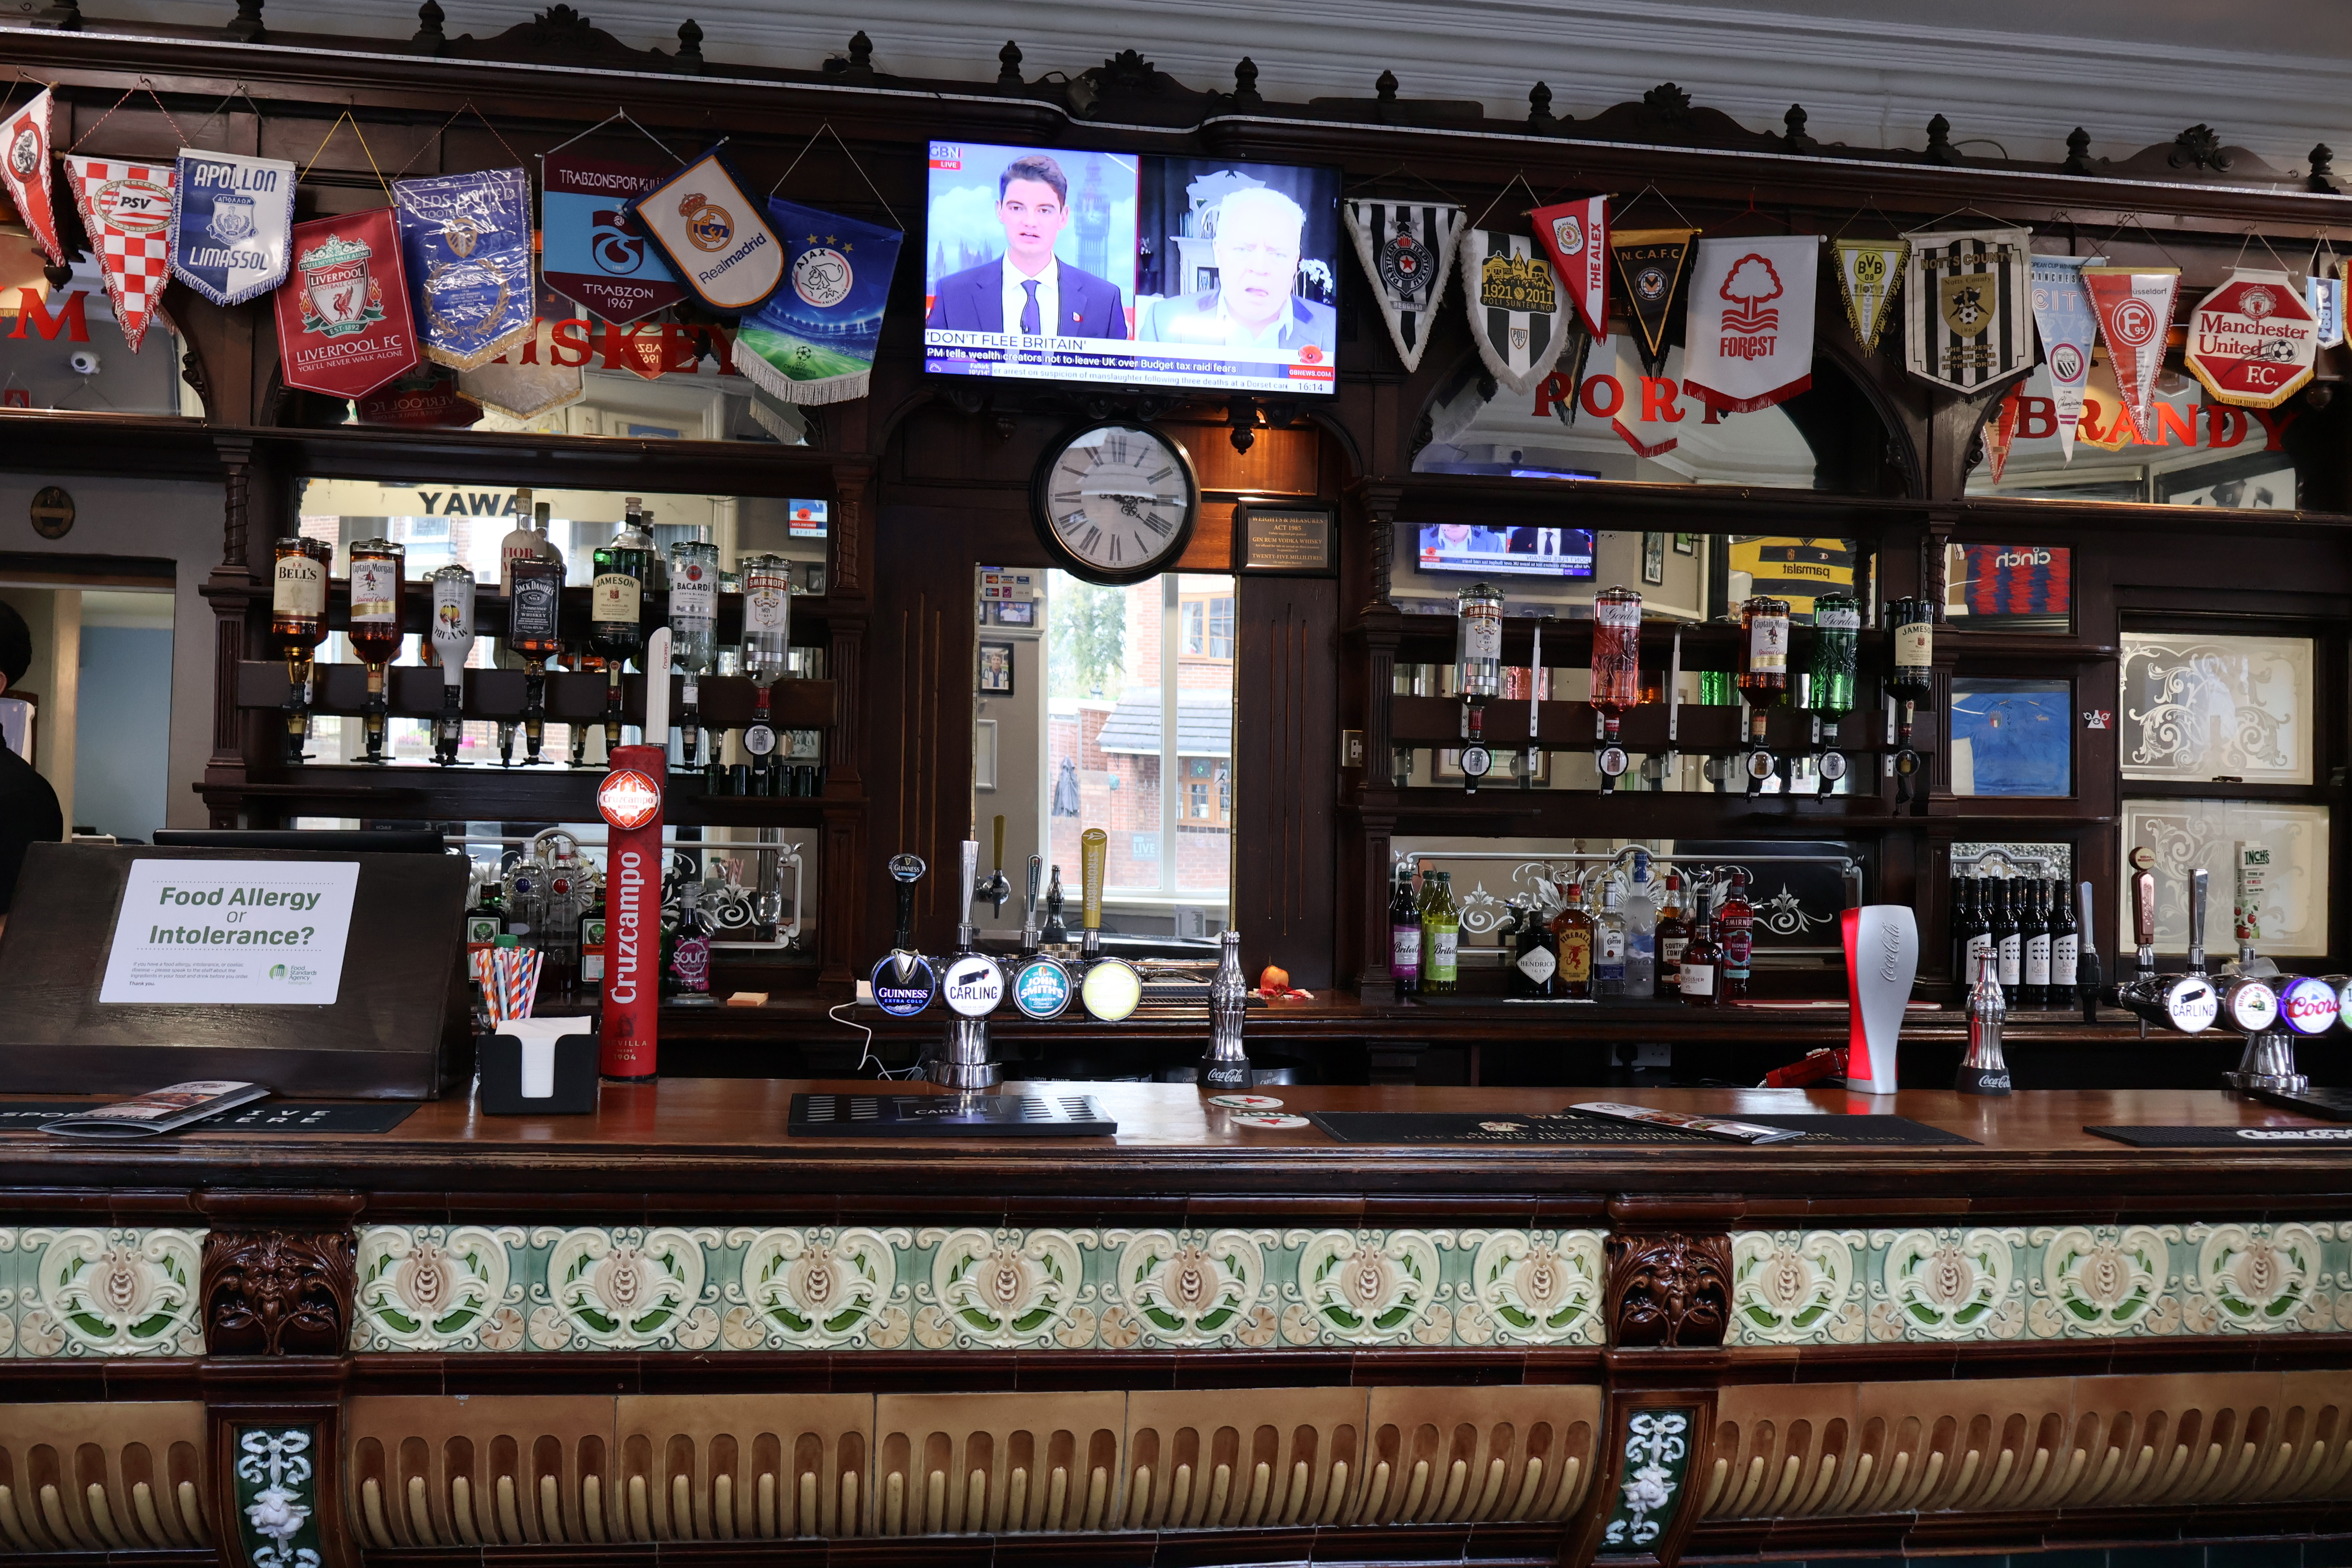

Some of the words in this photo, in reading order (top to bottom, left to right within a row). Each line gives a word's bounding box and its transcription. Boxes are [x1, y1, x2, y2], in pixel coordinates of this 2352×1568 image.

[929, 145, 960, 159] GBN
[194, 164, 277, 192] APOLLON
[560, 169, 636, 190] TRABZONSPOR
[120, 196, 152, 210] PSV
[405, 194, 450, 210] LEEDS
[1590, 222, 1601, 261] ALEX
[189, 247, 268, 270] LIMASSOL
[352, 250, 370, 259] ALONE
[796, 249, 826, 270] AJAX
[1920, 255, 1960, 270] NOTTS
[1963, 252, 2013, 265] COUNTY
[1858, 255, 1882, 274] BVB
[310, 267, 364, 286] LIVERPOOL
[1591, 263, 1601, 290] THE
[314, 282, 345, 292] FOOTBALL
[583, 283, 654, 298] TRABZON
[1483, 284, 1513, 299] 1921
[1526, 288, 1553, 304] 2011
[607, 298, 633, 309] 1967
[822, 288, 847, 305] AMSTERDAM
[1506, 299, 1536, 309] SUNTEM
[1393, 302, 1423, 310] BEOGRAD
[0, 286, 90, 342] M
[2134, 327, 2146, 335] 95
[2199, 313, 2309, 339] Manchester
[927, 332, 977, 345] 'DON'T
[982, 334, 1018, 347] FLEE
[1023, 337, 1087, 350] BRITAIN'
[1513, 330, 1525, 338] POLI
[296, 339, 379, 363] LIVERPOOL
[384, 335, 402, 348] FC
[2199, 334, 2262, 356] United
[298, 363, 325, 372] YOU'LL
[327, 358, 351, 368] NEVER
[352, 354, 374, 363] WALK
[377, 350, 403, 359] ALONE
[927, 348, 943, 357] PM
[945, 348, 966, 358] tells
[969, 349, 1001, 360] wealth
[1002, 352, 1042, 363] creators
[1044, 354, 1060, 364] not
[1062, 355, 1073, 365] to
[1074, 355, 1100, 366] leave
[1101, 356, 1117, 367] UK
[1117, 359, 1136, 368] over
[1140, 359, 1174, 371] Budget
[1176, 361, 1191, 371] tax
[1193, 361, 1210, 372] raid
[1213, 362, 1237, 373] fears
[1040, 368, 1078, 379] suspicion
[1089, 370, 1142, 383] manslaughter
[1144, 374, 1180, 385] following
[1181, 376, 1201, 385] three
[1203, 377, 1229, 386] deaths
[1247, 380, 1271, 388] Dorset
[1289, 368, 1332, 377] GBNEWS.COM
[2246, 365, 2279, 386] F.C.
[1298, 382, 1323, 392] 16:14
[503, 547, 533, 558] FIOR
[278, 566, 317, 580] BELL'S
[352, 563, 370, 574] Captain
[515, 583, 530, 594] JACK
[597, 577, 635, 588] JAMESON
[749, 578, 786, 588] SMIRNOFF
[1754, 619, 1773, 630] Captain
[603, 794, 653, 805] Cruzcampo
[1132, 842, 1156, 854] LIVE
[894, 864, 920, 873] GUINNESS
[1086, 852, 1099, 912] STRONGBOW
[159, 887, 224, 906] Food
[228, 887, 321, 911] Allergy
[226, 909, 247, 924] or
[149, 925, 315, 946] Intolerance?
[610, 852, 645, 1004] Cruzcampo
[1560, 932, 1590, 943] FIREBALL
[1026, 976, 1058, 987] JOHN
[878, 987, 928, 998] GUINNESS
[950, 986, 998, 1000] CARLING
[1021, 984, 1064, 999] SMITH'S
[2238, 987, 2253, 1007] BIRRA
[2173, 1004, 2214, 1017] CARLING
[2286, 997, 2341, 1018] Coors
[1207, 1067, 1243, 1083] Coca-Cola
[1260, 1076, 1279, 1085] CARLING
